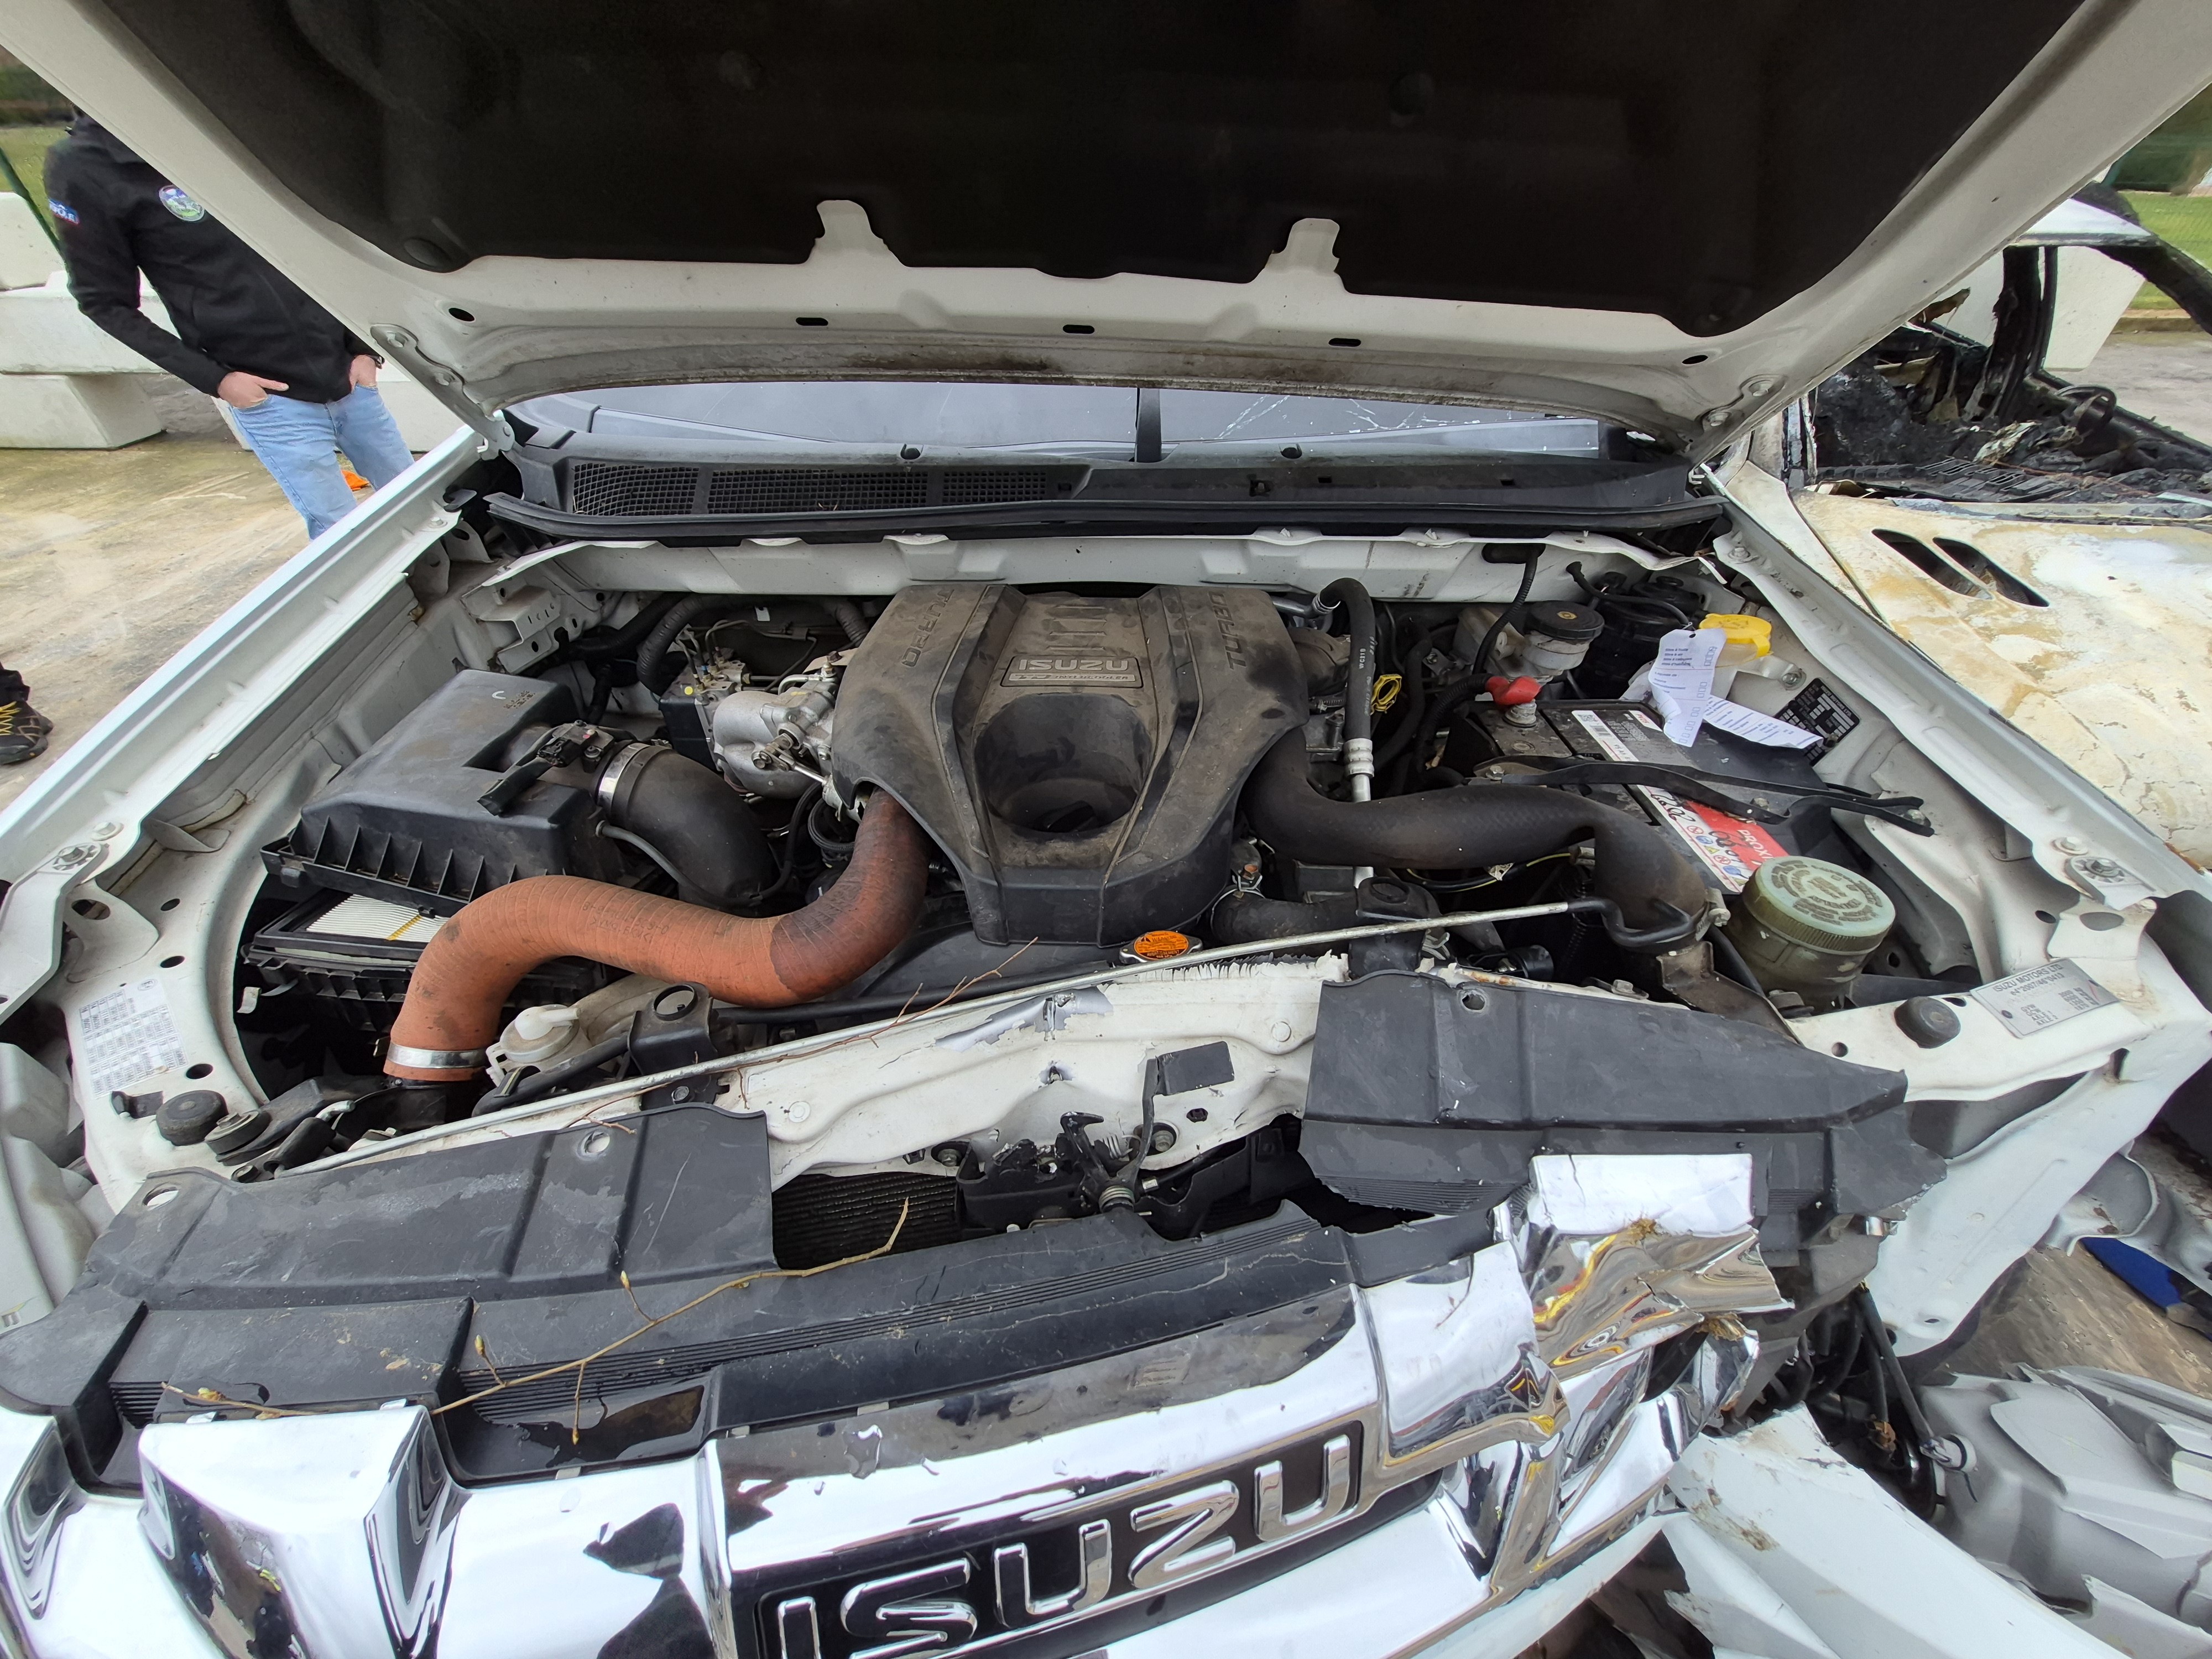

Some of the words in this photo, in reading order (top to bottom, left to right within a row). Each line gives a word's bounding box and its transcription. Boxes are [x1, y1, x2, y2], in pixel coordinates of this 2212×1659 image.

[1208, 591, 1247, 670] TURBO
[1019, 659, 1128, 671] ISUZU
[1992, 978, 2017, 993] ISUZU
[2018, 968, 2049, 984] MOTORS
[778, 1436, 1351, 1659] ISUZU
